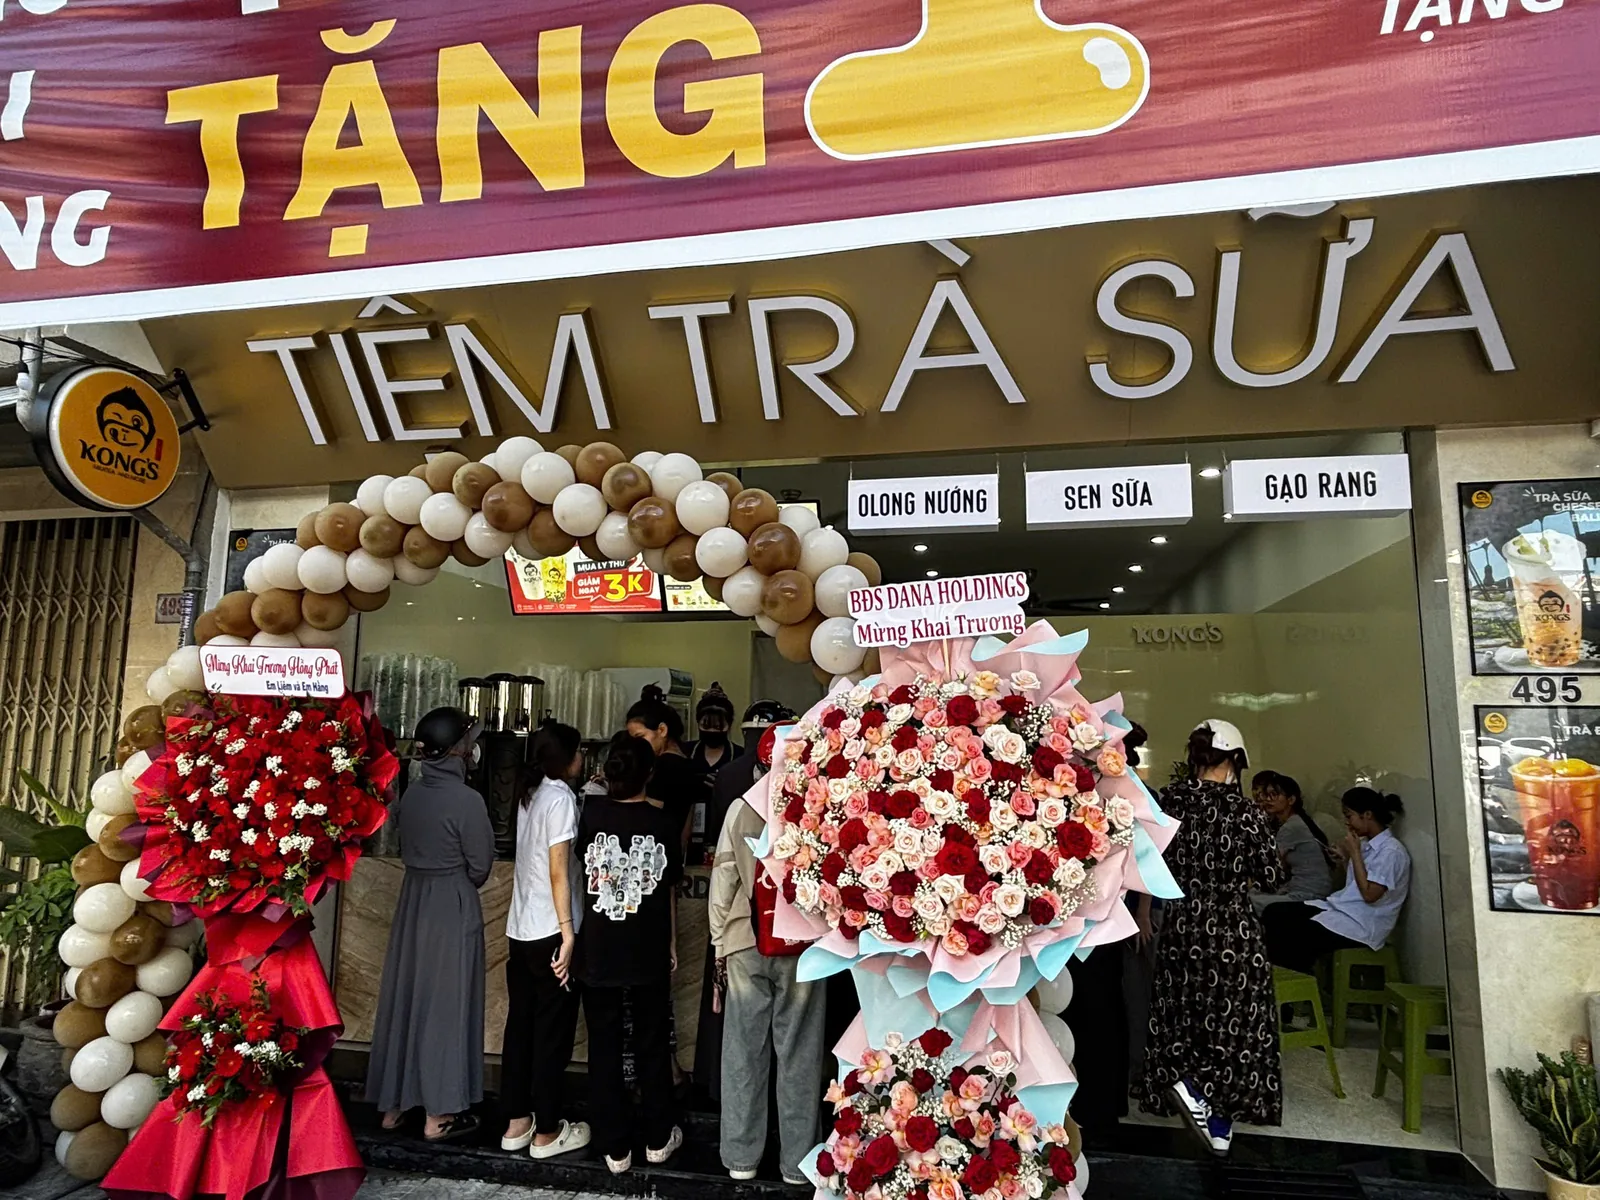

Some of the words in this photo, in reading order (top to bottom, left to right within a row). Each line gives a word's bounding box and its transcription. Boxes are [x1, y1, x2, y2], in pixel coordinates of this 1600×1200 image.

[165, 3, 766, 258] TẶNG
[648, 238, 1027, 424] TRÀ
[1088, 201, 1516, 400] SỮA
[79, 439, 159, 480] KONG'S
[858, 491, 915, 517] OLONG
[925, 486, 988, 514] NƯỚNG
[1064, 484, 1101, 510] SEN
[1112, 478, 1153, 507] SỮA
[1265, 472, 1308, 503] GẠO
[1318, 471, 1377, 498] RANG
[1533, 491, 1560, 502] TRÀ
[850, 588, 883, 613] BĐS
[887, 582, 934, 609] DANA
[938, 573, 1026, 605] HOLDINGS
[857, 621, 908, 646] Mừng
[911, 616, 951, 639] Khai
[955, 613, 1023, 634] Trương
[1132, 622, 1223, 644] KONG'S
[232, 654, 255, 674] Khai
[266, 680, 277, 690] Em
[1512, 676, 1582, 703] 495
[1562, 724, 1592, 736] TRÀ
